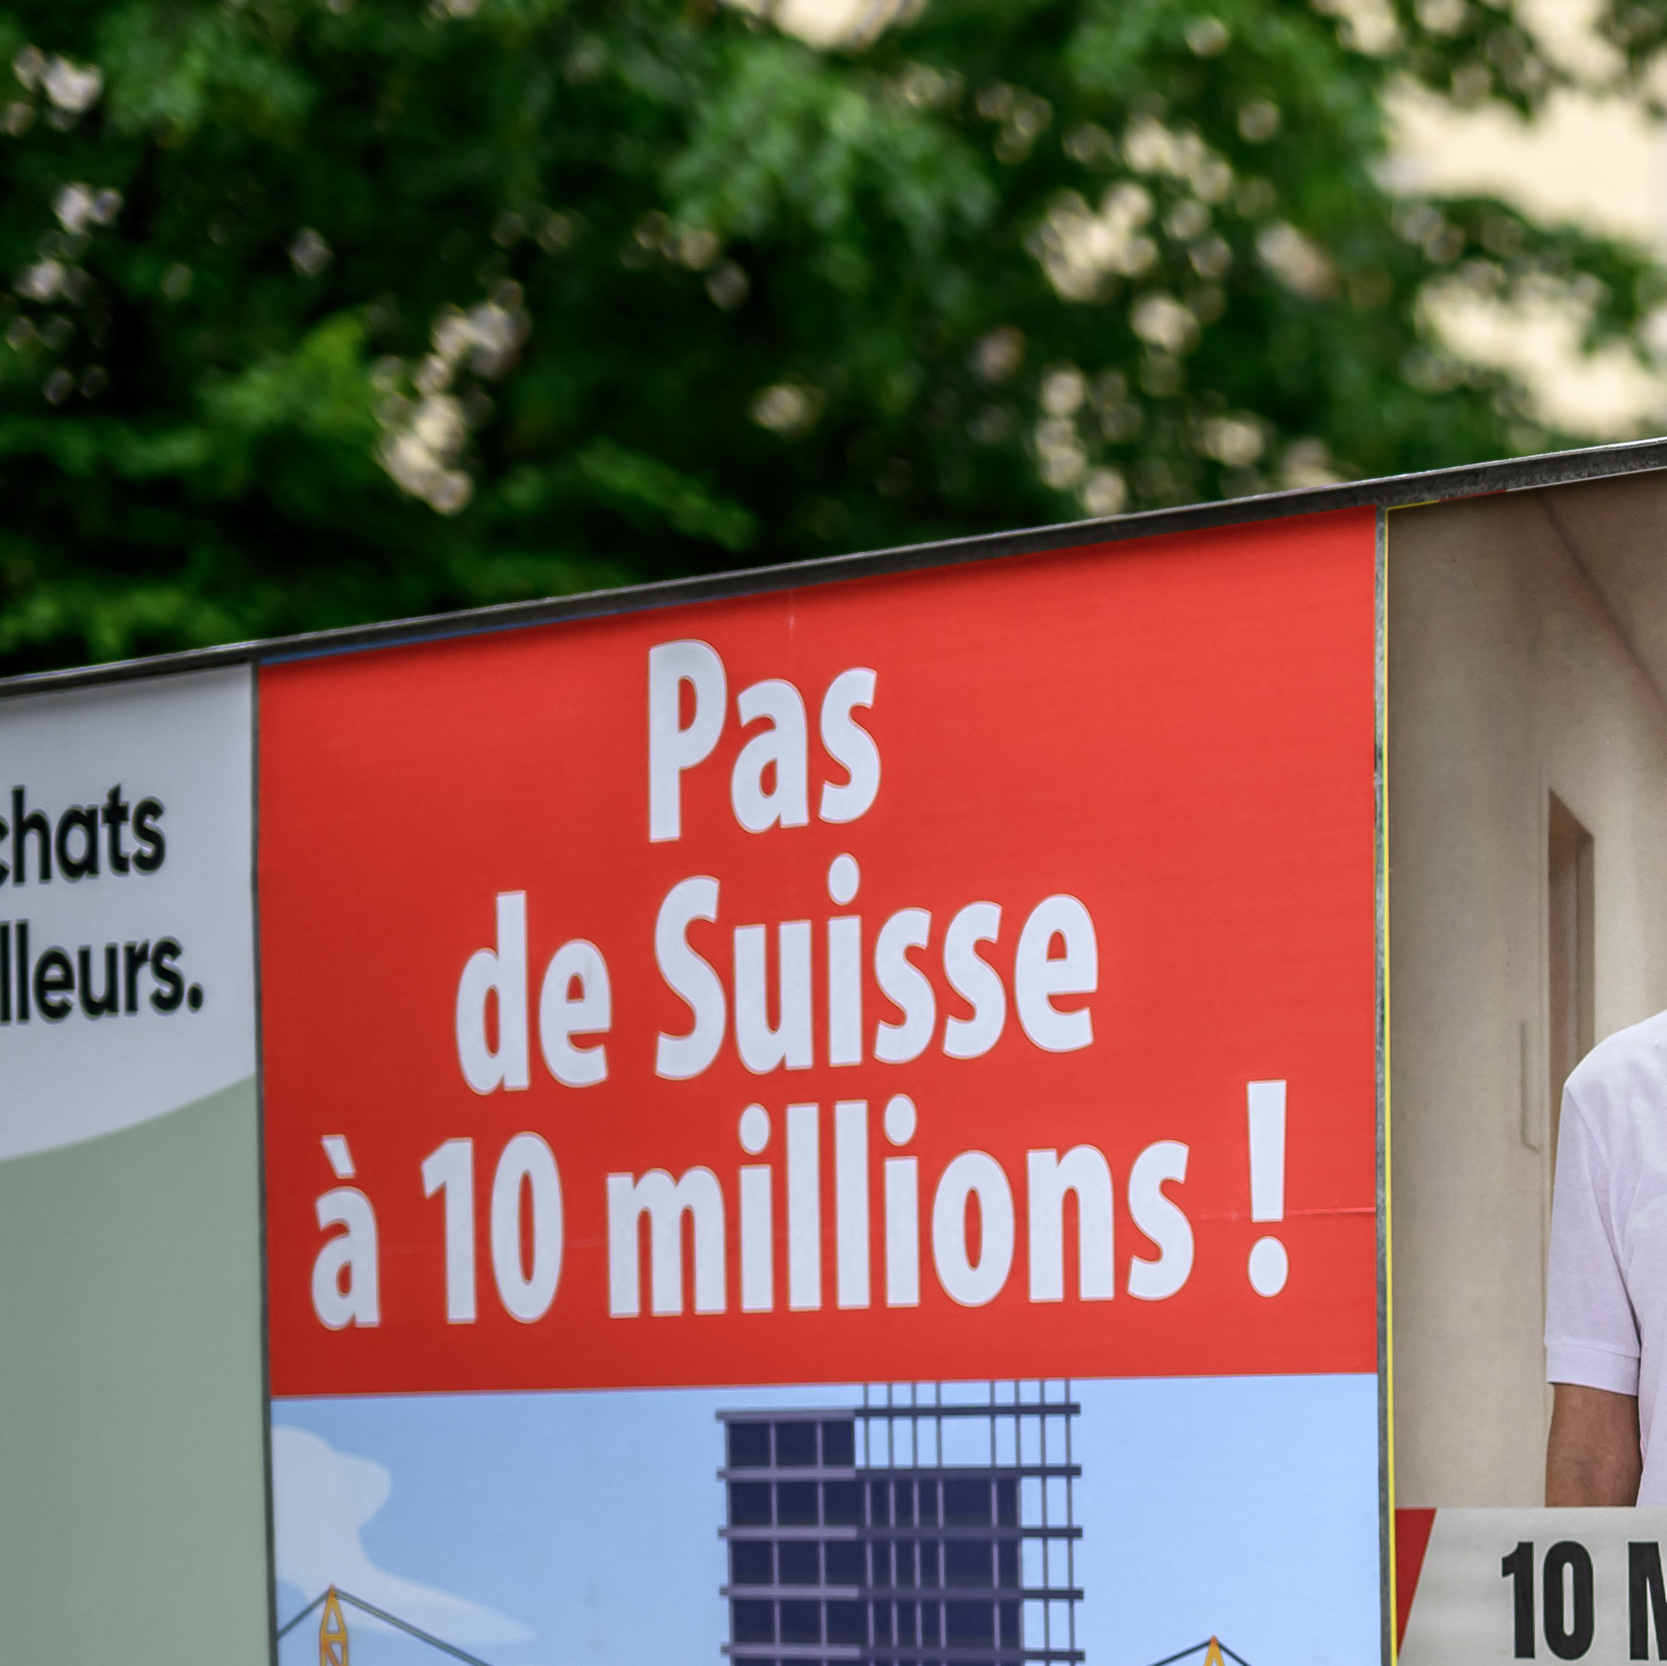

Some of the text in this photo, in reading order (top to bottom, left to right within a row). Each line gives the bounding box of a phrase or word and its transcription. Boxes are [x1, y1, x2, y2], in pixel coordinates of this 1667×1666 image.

[0, 783, 166, 886] hats
[648, 638, 882, 843] Pas
[456, 853, 1098, 1095] de Suisse
[312, 1079, 1289, 1331] à 10 millions !
[1501, 1541, 1594, 1661] 10
